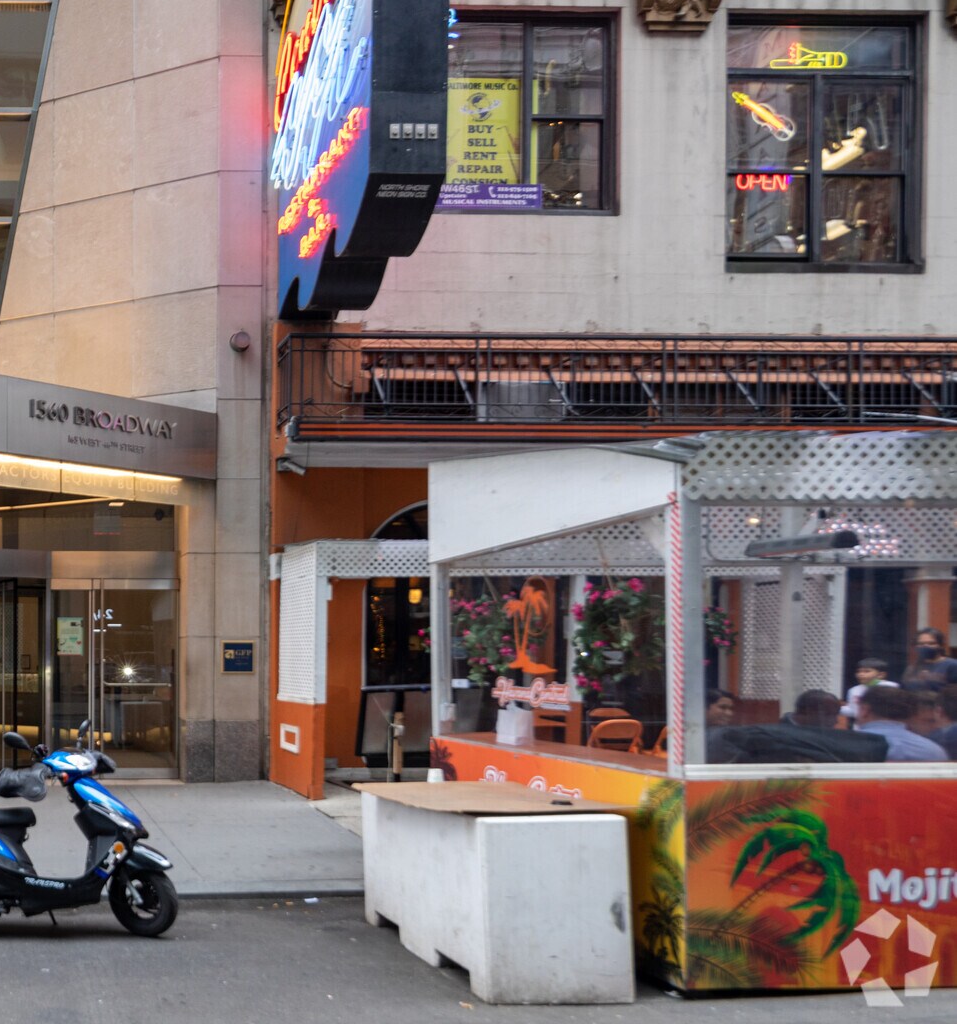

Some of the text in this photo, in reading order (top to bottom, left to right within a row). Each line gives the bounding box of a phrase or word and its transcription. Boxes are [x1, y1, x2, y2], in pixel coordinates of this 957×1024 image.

[467, 125, 494, 134] BUY
[467, 138, 497, 147] SELL
[463, 152, 498, 160] RENT
[457, 165, 503, 174] REPAIR
[736, 174, 789, 192] OPEN
[299, 213, 338, 257] BAR
[28, 398, 178, 440] 1560 BROADWAY
[119, 442, 146, 454] STREET
[64, 470, 115, 488] EQUITY
[117, 478, 179, 496] BUILDING
